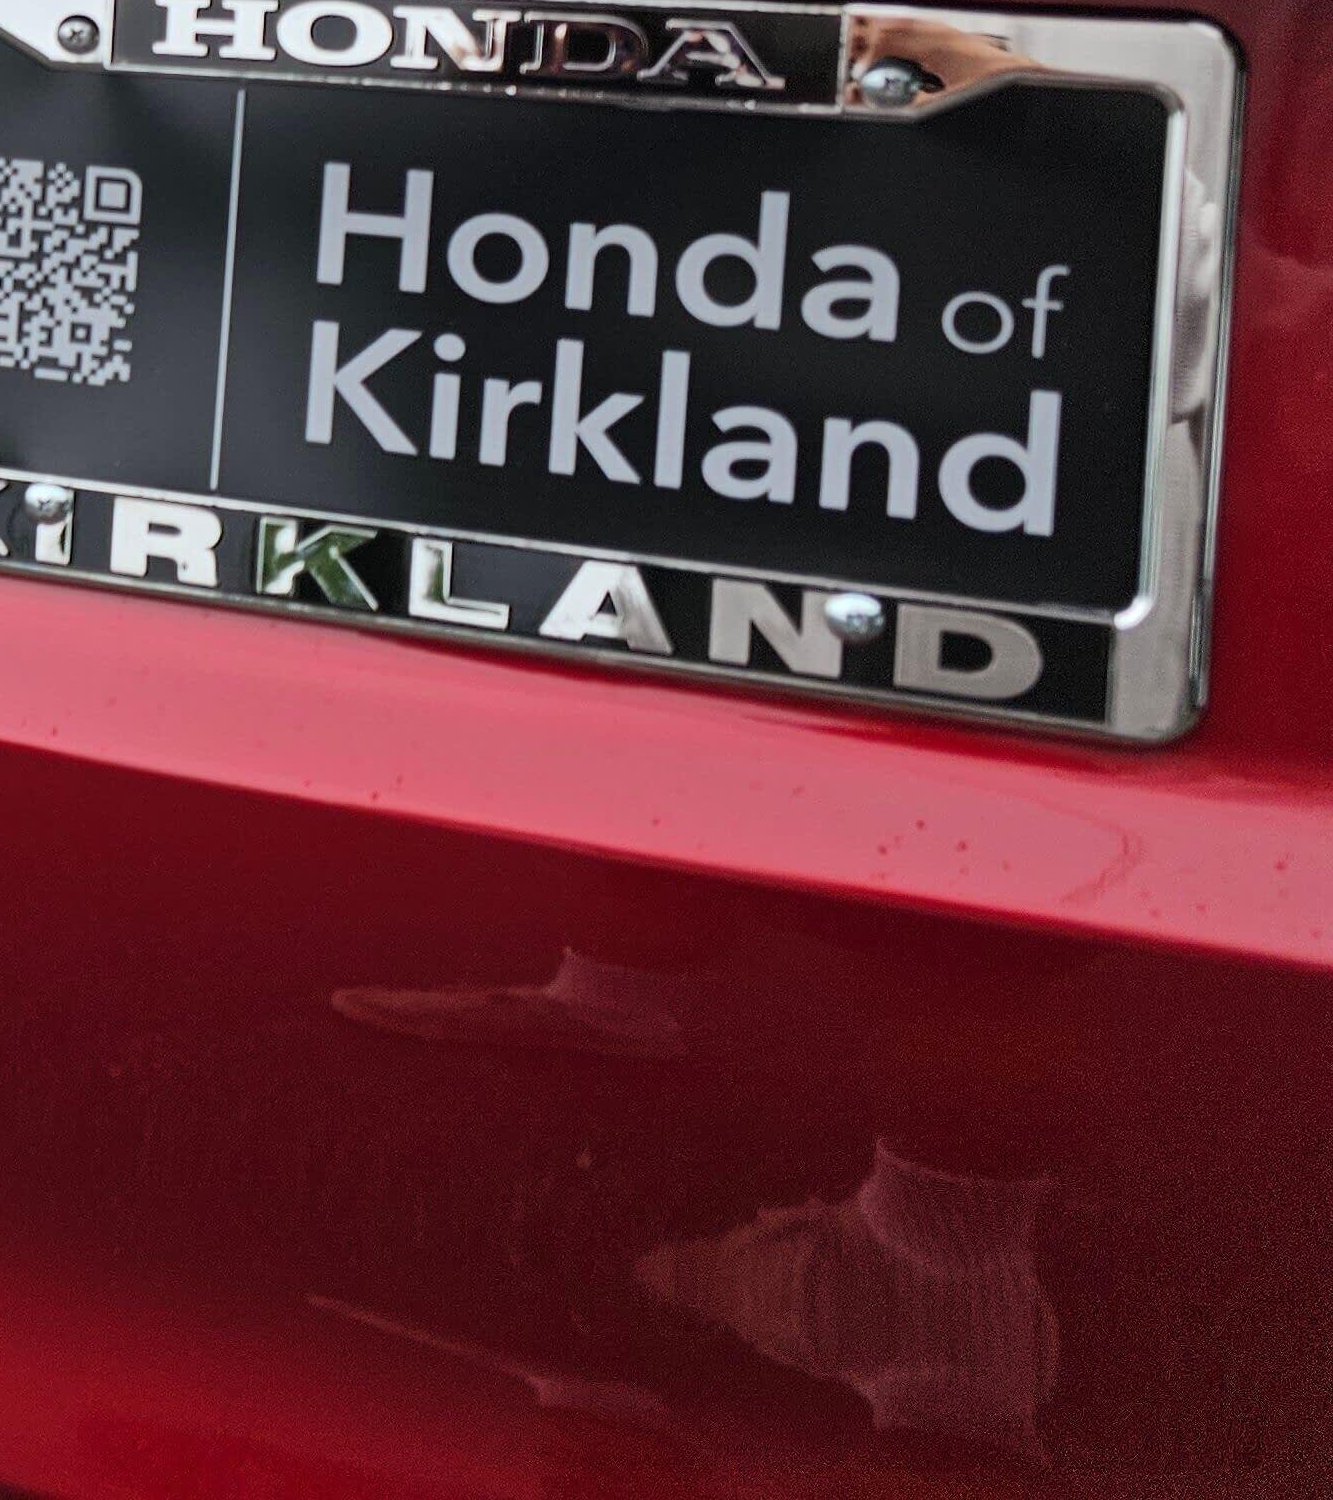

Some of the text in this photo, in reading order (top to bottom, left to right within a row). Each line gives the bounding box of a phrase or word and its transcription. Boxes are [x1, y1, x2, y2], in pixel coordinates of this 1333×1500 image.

[315, 161, 1070, 361] Honda of
[302, 320, 1062, 539] Kirkland
